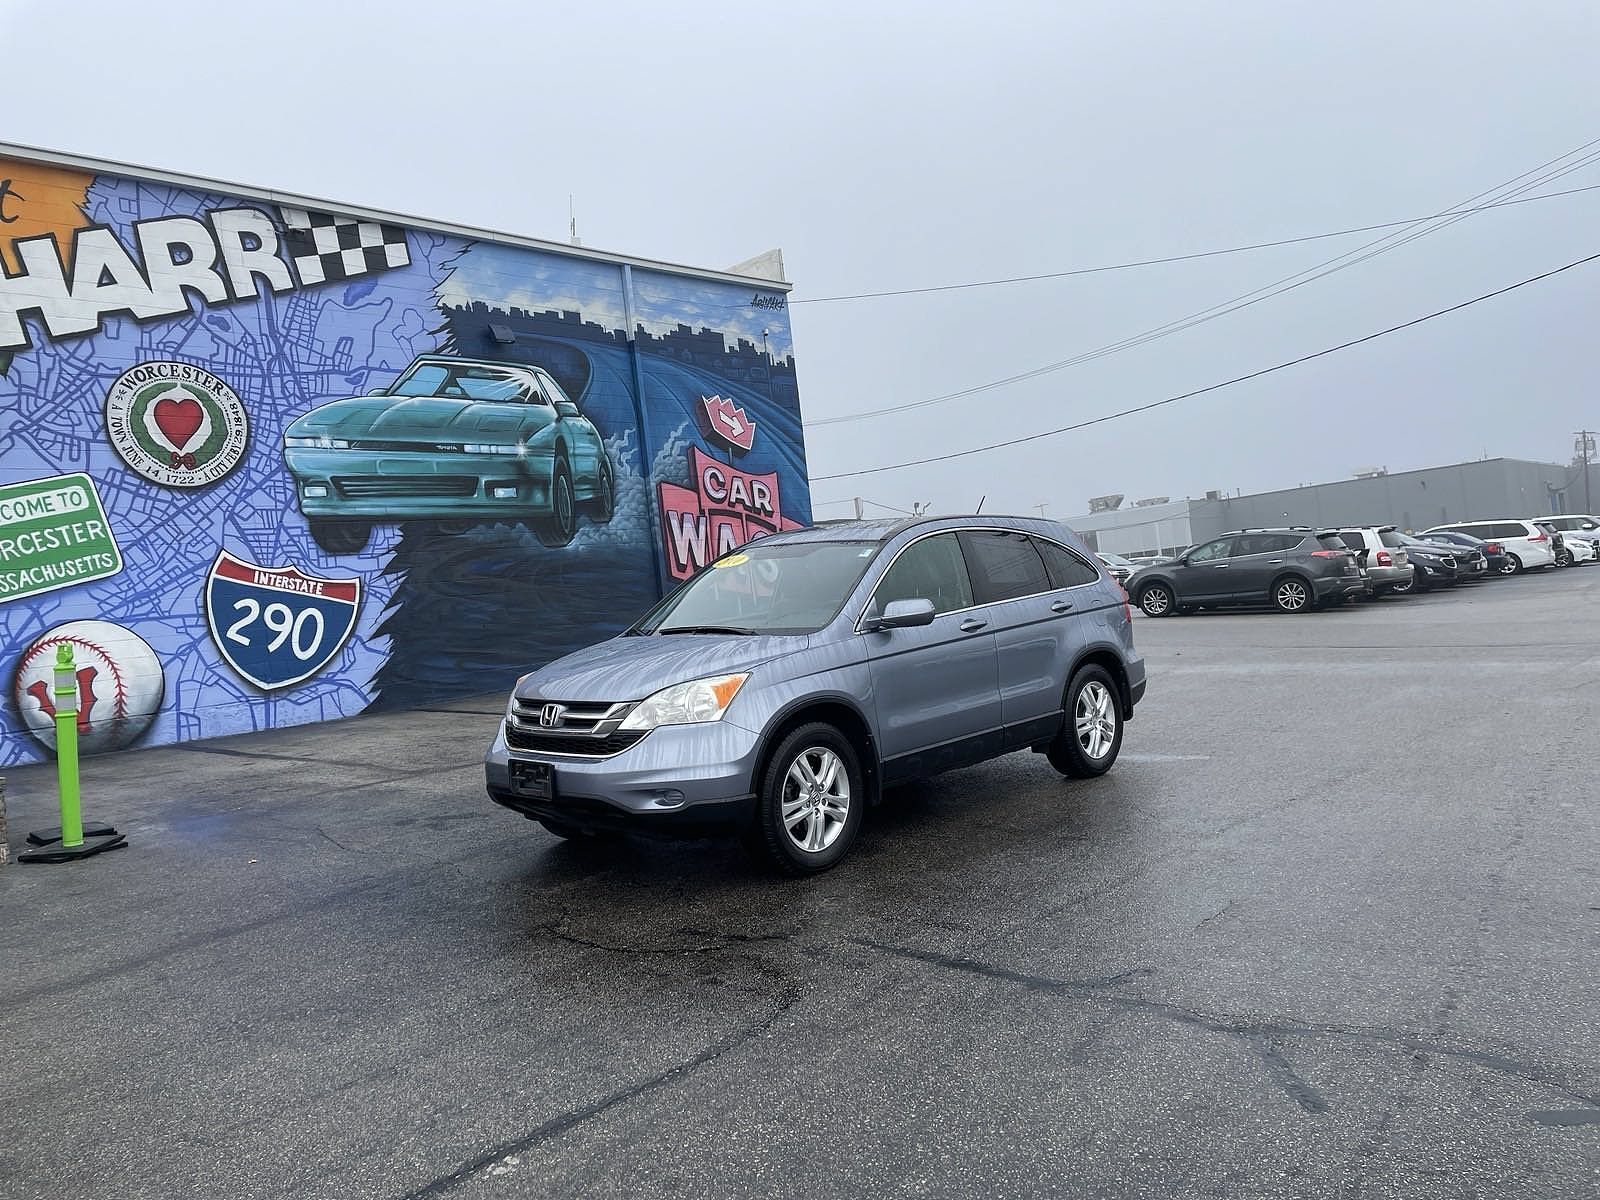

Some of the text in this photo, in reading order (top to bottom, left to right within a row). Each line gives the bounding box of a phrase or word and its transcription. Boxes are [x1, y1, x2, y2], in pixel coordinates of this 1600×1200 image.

[120, 364, 224, 396] WORCESTER
[111, 415, 127, 443] TOWN
[122, 444, 144, 468] JUNE
[166, 474, 195, 484] 1722
[211, 461, 229, 478] CITY
[0, 490, 82, 520] COME TO
[702, 465, 774, 515] CAR
[0, 520, 106, 561] RCESTER
[253, 570, 324, 595] INTERSTATE
[226, 598, 325, 661] 290
